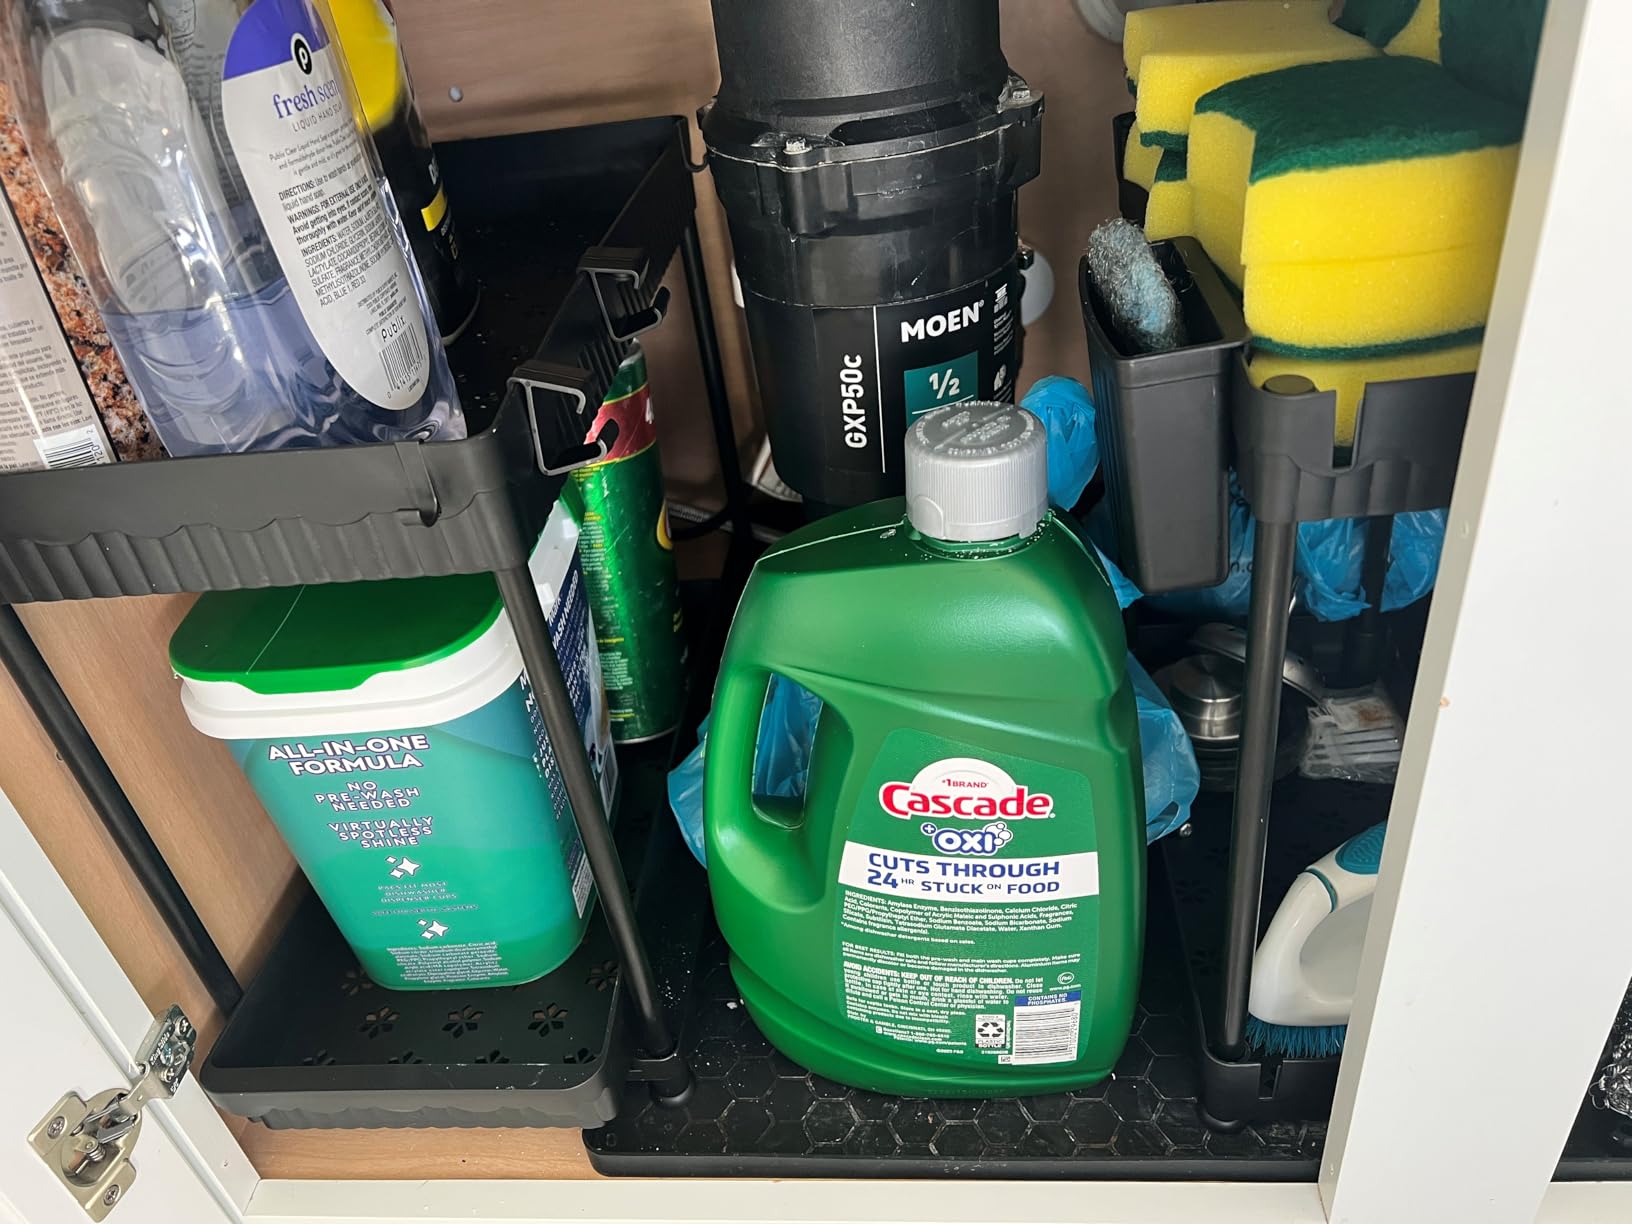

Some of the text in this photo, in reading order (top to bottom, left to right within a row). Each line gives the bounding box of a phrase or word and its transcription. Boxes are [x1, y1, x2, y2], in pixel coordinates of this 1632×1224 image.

[273, 85, 318, 118] fresh
[292, 109, 334, 132] LIQUID HAND
[279, 180, 316, 201] DIRECTIONS:
[282, 198, 299, 212] liquid
[299, 194, 314, 205] hand
[287, 191, 349, 224] WARNINGS: FOR EXTERNAL
[293, 221, 309, 235] Avoid
[310, 214, 328, 228] getting
[328, 209, 337, 218] into
[297, 226, 326, 245] thoroughly
[327, 221, 337, 230] with
[301, 234, 337, 257] INGREDIENTS:
[305, 239, 349, 267] SODIUM CHLORIDE,
[312, 270, 336, 287] SULFATE,
[333, 286, 348, 300] BLUE
[351, 278, 360, 289] RED
[382, 315, 406, 342] Publix
[901, 302, 980, 343] MOEN
[269, 735, 429, 760] ALL-IN-ONE
[289, 753, 422, 775] FORMULA
[347, 782, 376, 791] NO
[953, 780, 987, 788] BRAND
[315, 788, 420, 804] PRE-WASH
[332, 798, 410, 812] NEEDED
[882, 784, 1050, 817] Cascade
[328, 817, 433, 832] VIRTUALLY
[339, 827, 432, 841] SPOTLESS
[361, 837, 418, 849] SHINE
[869, 853, 1060, 878] CUTS THROUGH
[868, 869, 898, 889] 24
[901, 878, 915, 886] HR
[921, 881, 984, 894] STUCK
[1007, 882, 1060, 894] FOOD
[845, 890, 887, 905] INGREDIENTS:
[888, 900, 912, 909] Amylase
[914, 903, 939, 912] Enzyme,
[845, 896, 858, 905] Acid,
[890, 906, 923, 917] Copolymer
[932, 911, 953, 919] Acrylic
[1039, 910, 1073, 918] Fragrances,
[868, 920, 896, 930] fragrance
[896, 920, 933, 929] Tetrasodium
[933, 923, 965, 931] Glutamate
[863, 965, 901, 977] ACCIDENTS:
